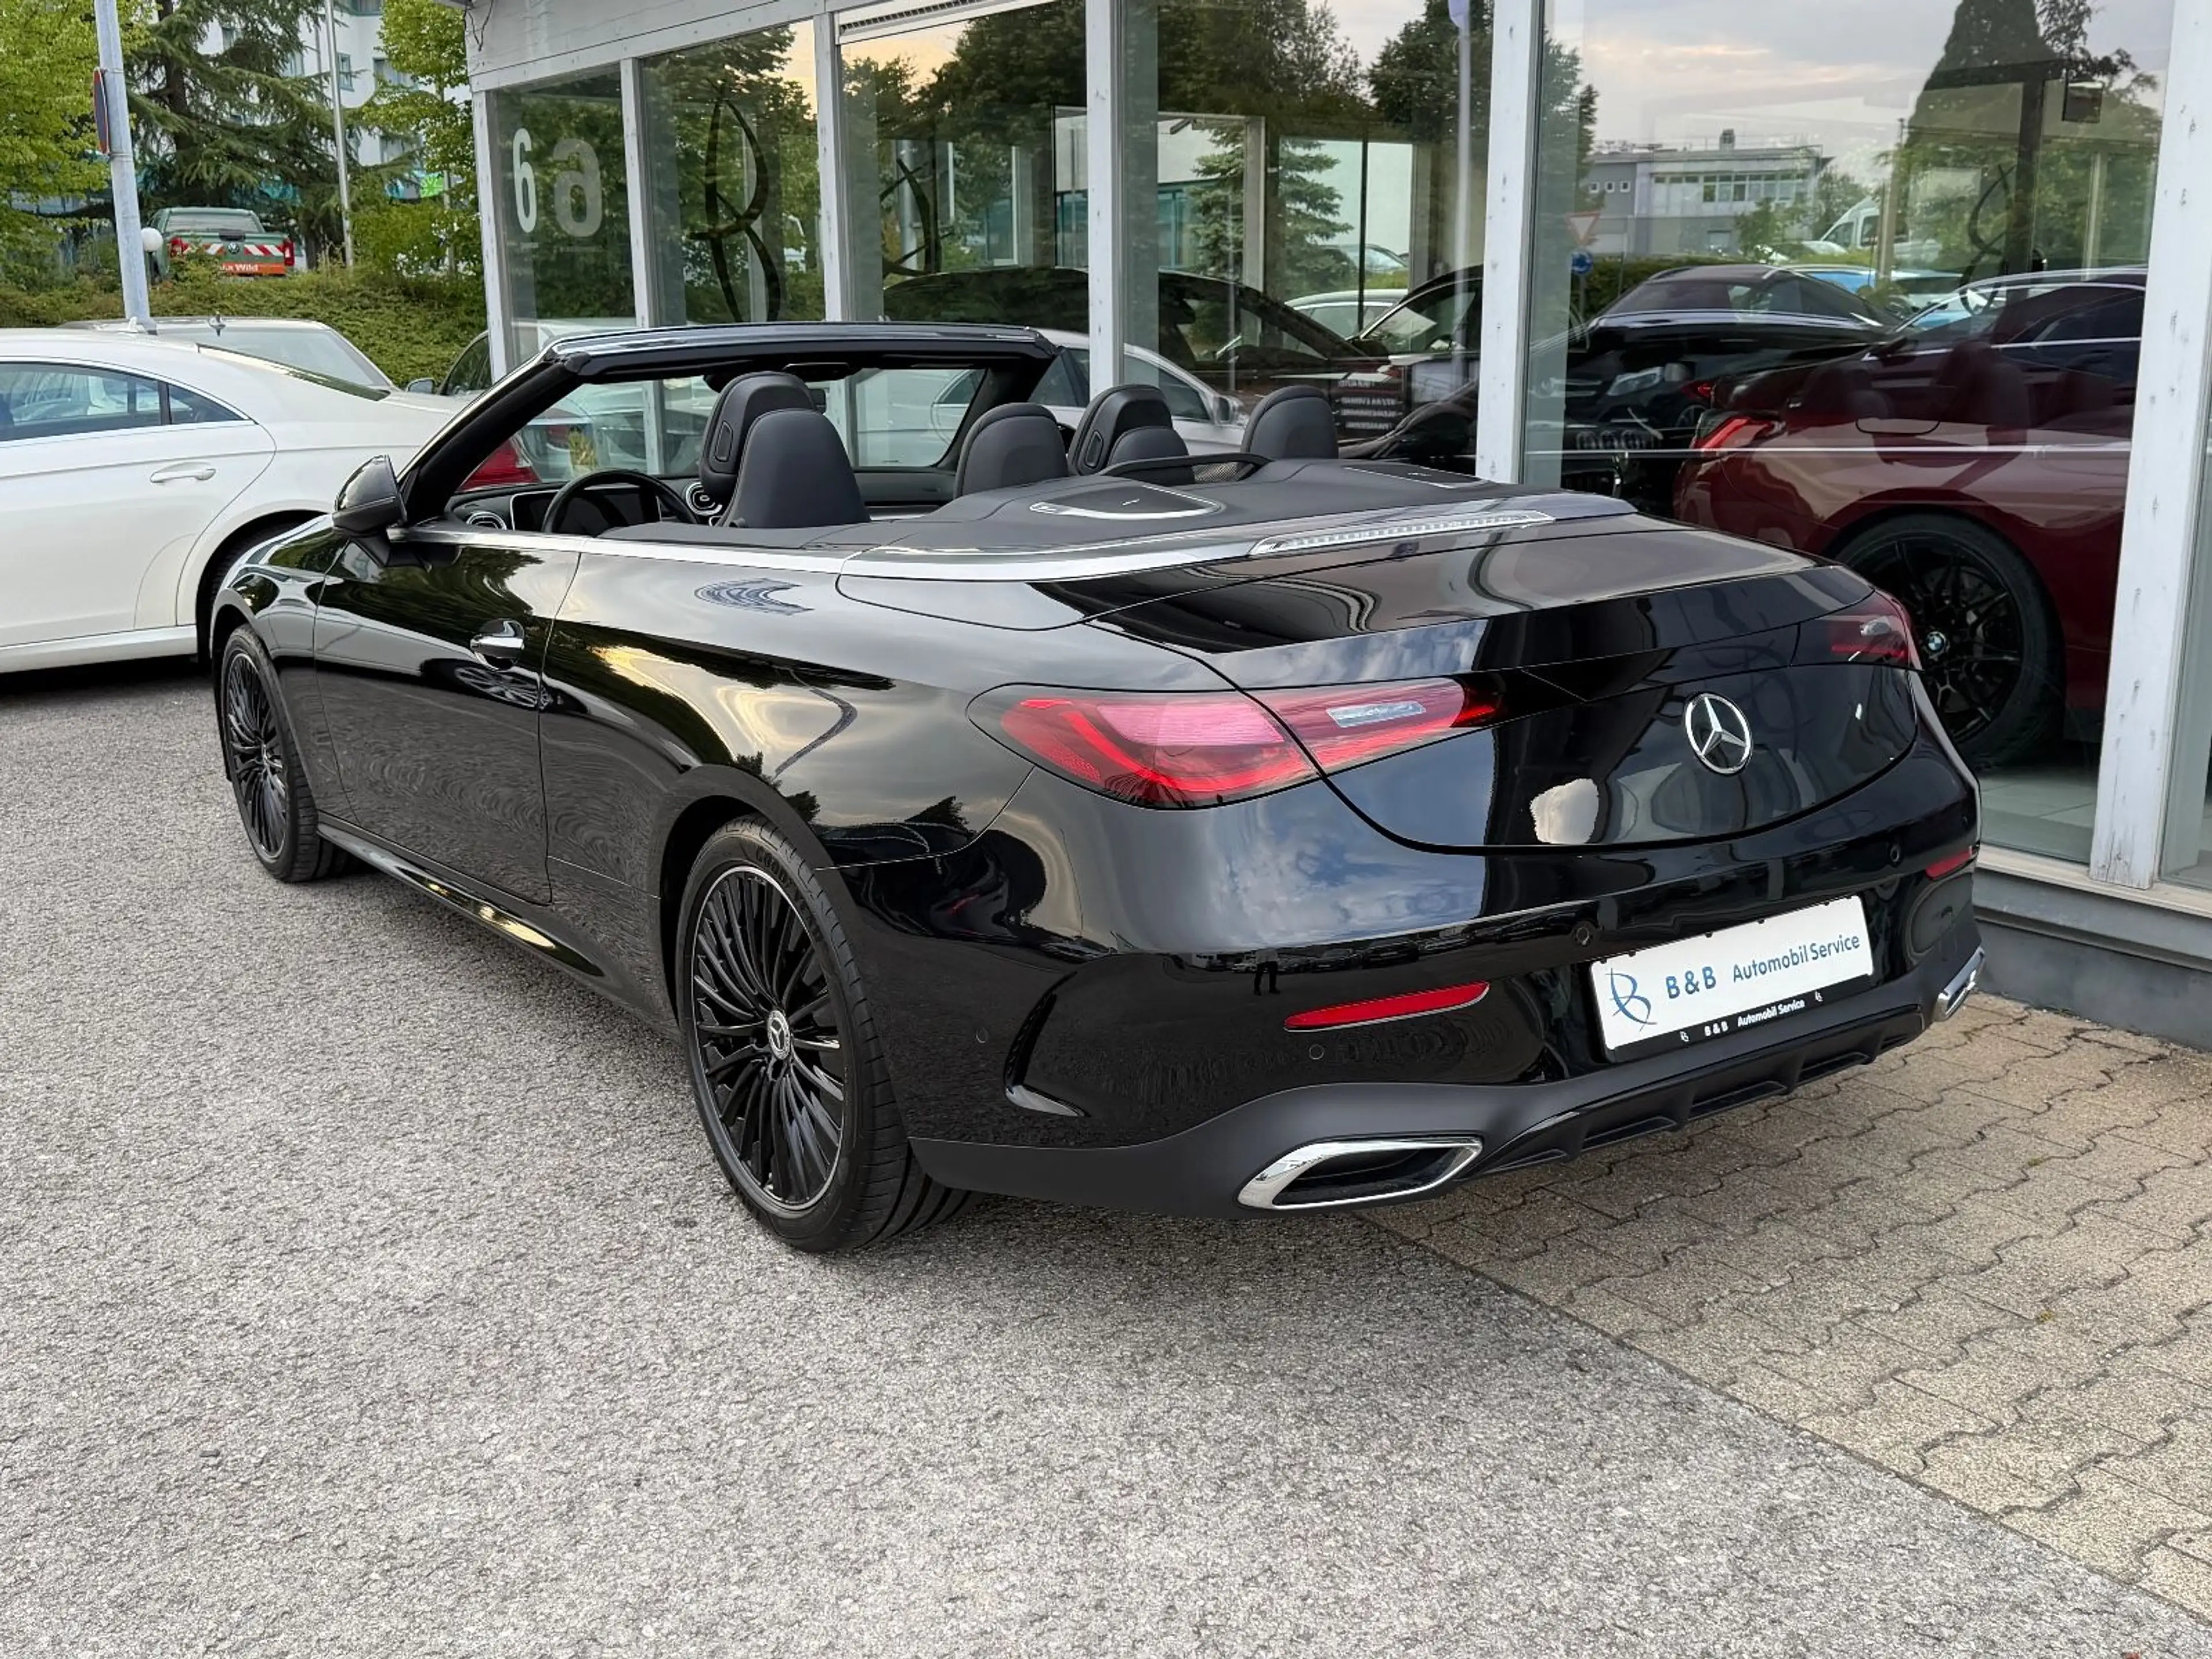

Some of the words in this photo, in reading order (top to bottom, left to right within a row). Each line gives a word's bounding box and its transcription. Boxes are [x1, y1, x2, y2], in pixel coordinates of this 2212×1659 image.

[512, 128, 537, 233] 6
[1666, 976, 1680, 999] B
[1684, 971, 1700, 995] &
[1702, 966, 1716, 990] B
[1733, 945, 1809, 983] Automobil
[1810, 934, 1860, 961] Service
[1705, 1026, 1711, 1036] B
[1713, 1023, 1721, 1034] &
[1721, 1021, 1729, 1032] B
[1737, 1005, 1778, 1027] Automobil
[1778, 999, 1805, 1014] Service
